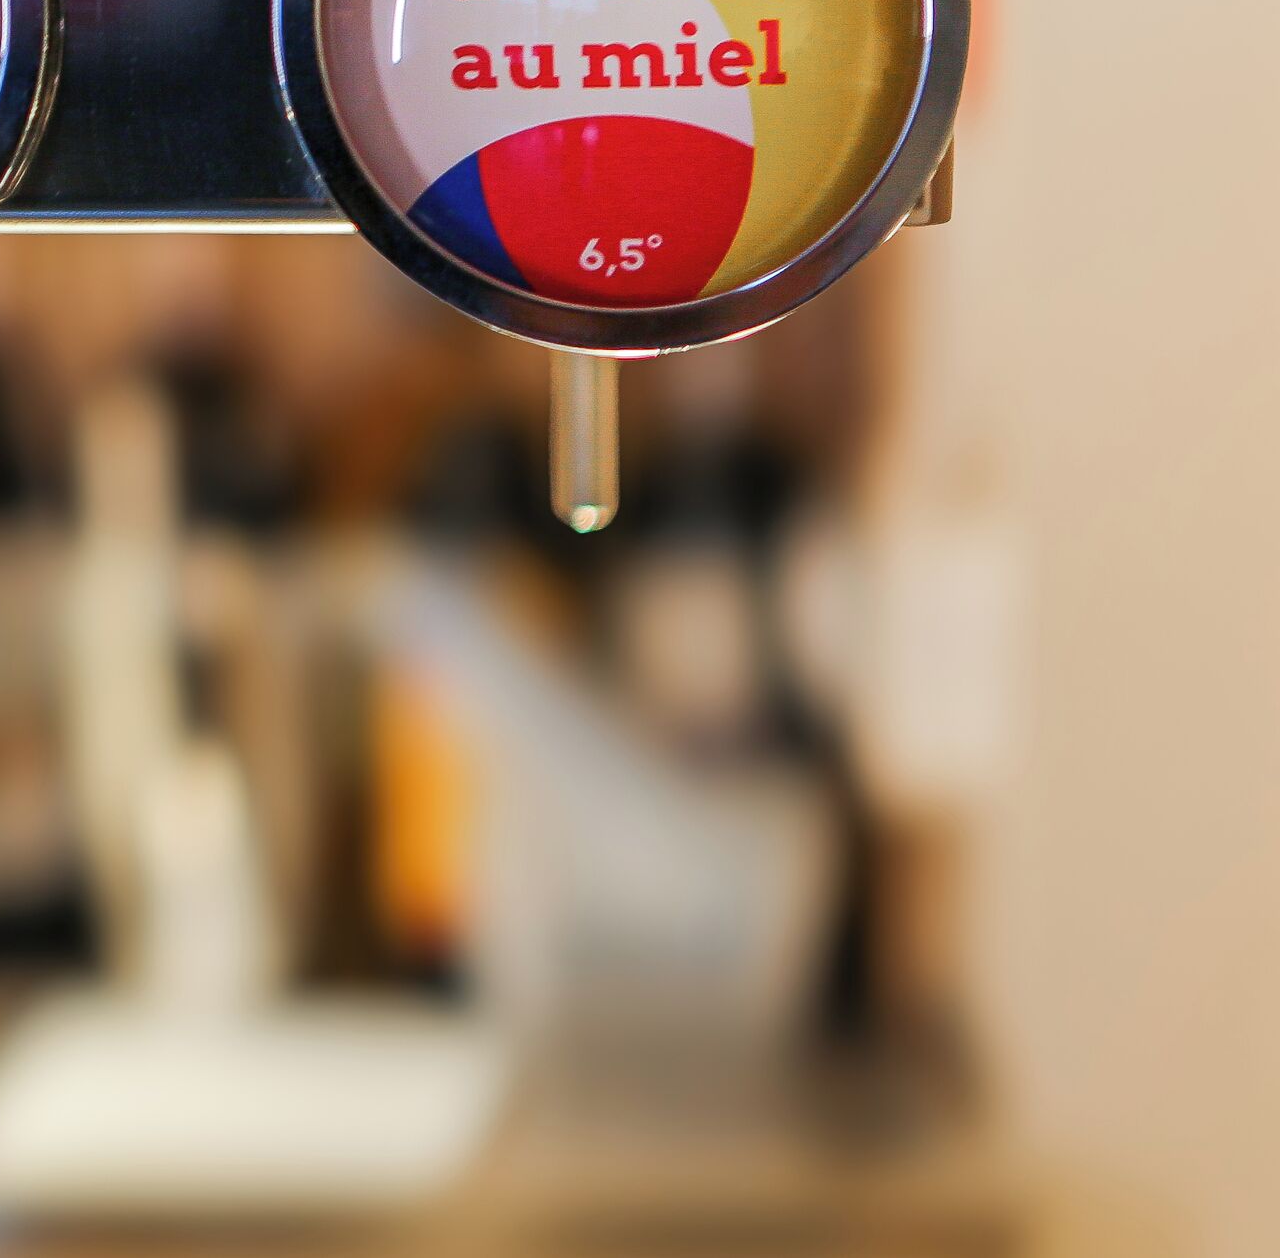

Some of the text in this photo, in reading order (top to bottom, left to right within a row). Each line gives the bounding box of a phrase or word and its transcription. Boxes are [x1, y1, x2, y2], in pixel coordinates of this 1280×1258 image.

[452, 19, 788, 89] au miel
[579, 233, 664, 278] 6,5°
